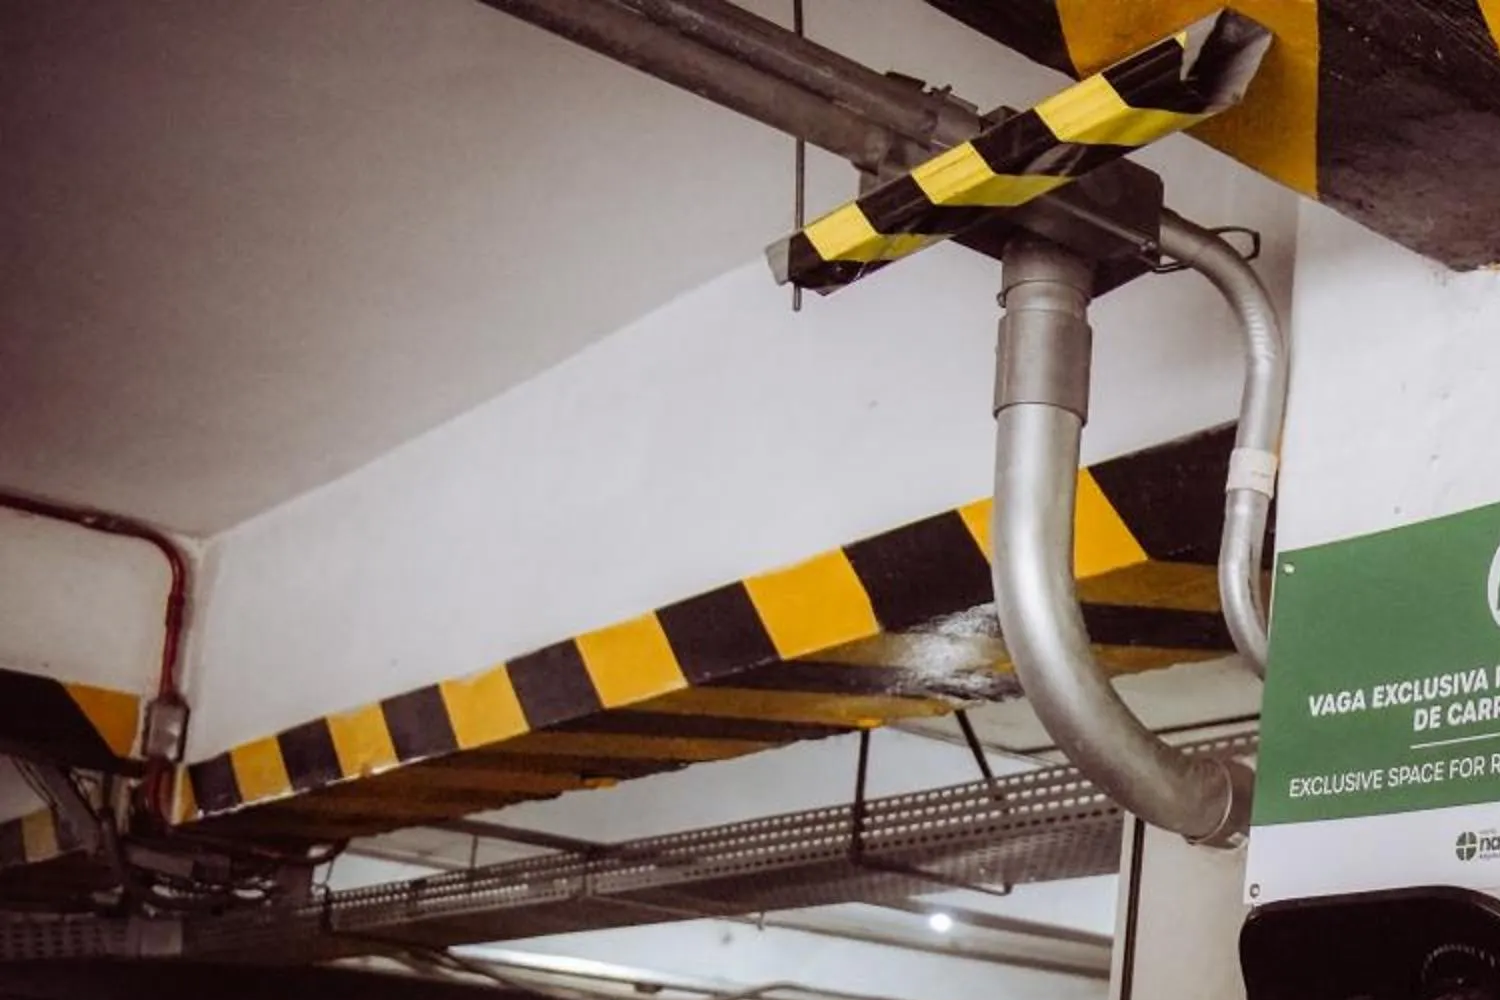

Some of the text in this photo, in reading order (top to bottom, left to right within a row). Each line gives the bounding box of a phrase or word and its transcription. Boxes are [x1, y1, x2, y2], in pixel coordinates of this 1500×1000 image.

[1308, 688, 1367, 717] VAGA
[1371, 667, 1490, 709] EXCLUSIVA
[1413, 706, 1442, 732] DE
[1289, 769, 1384, 798] EXCLUSIVE
[1387, 761, 1445, 788] SPACE
[1449, 756, 1485, 779] FOR
